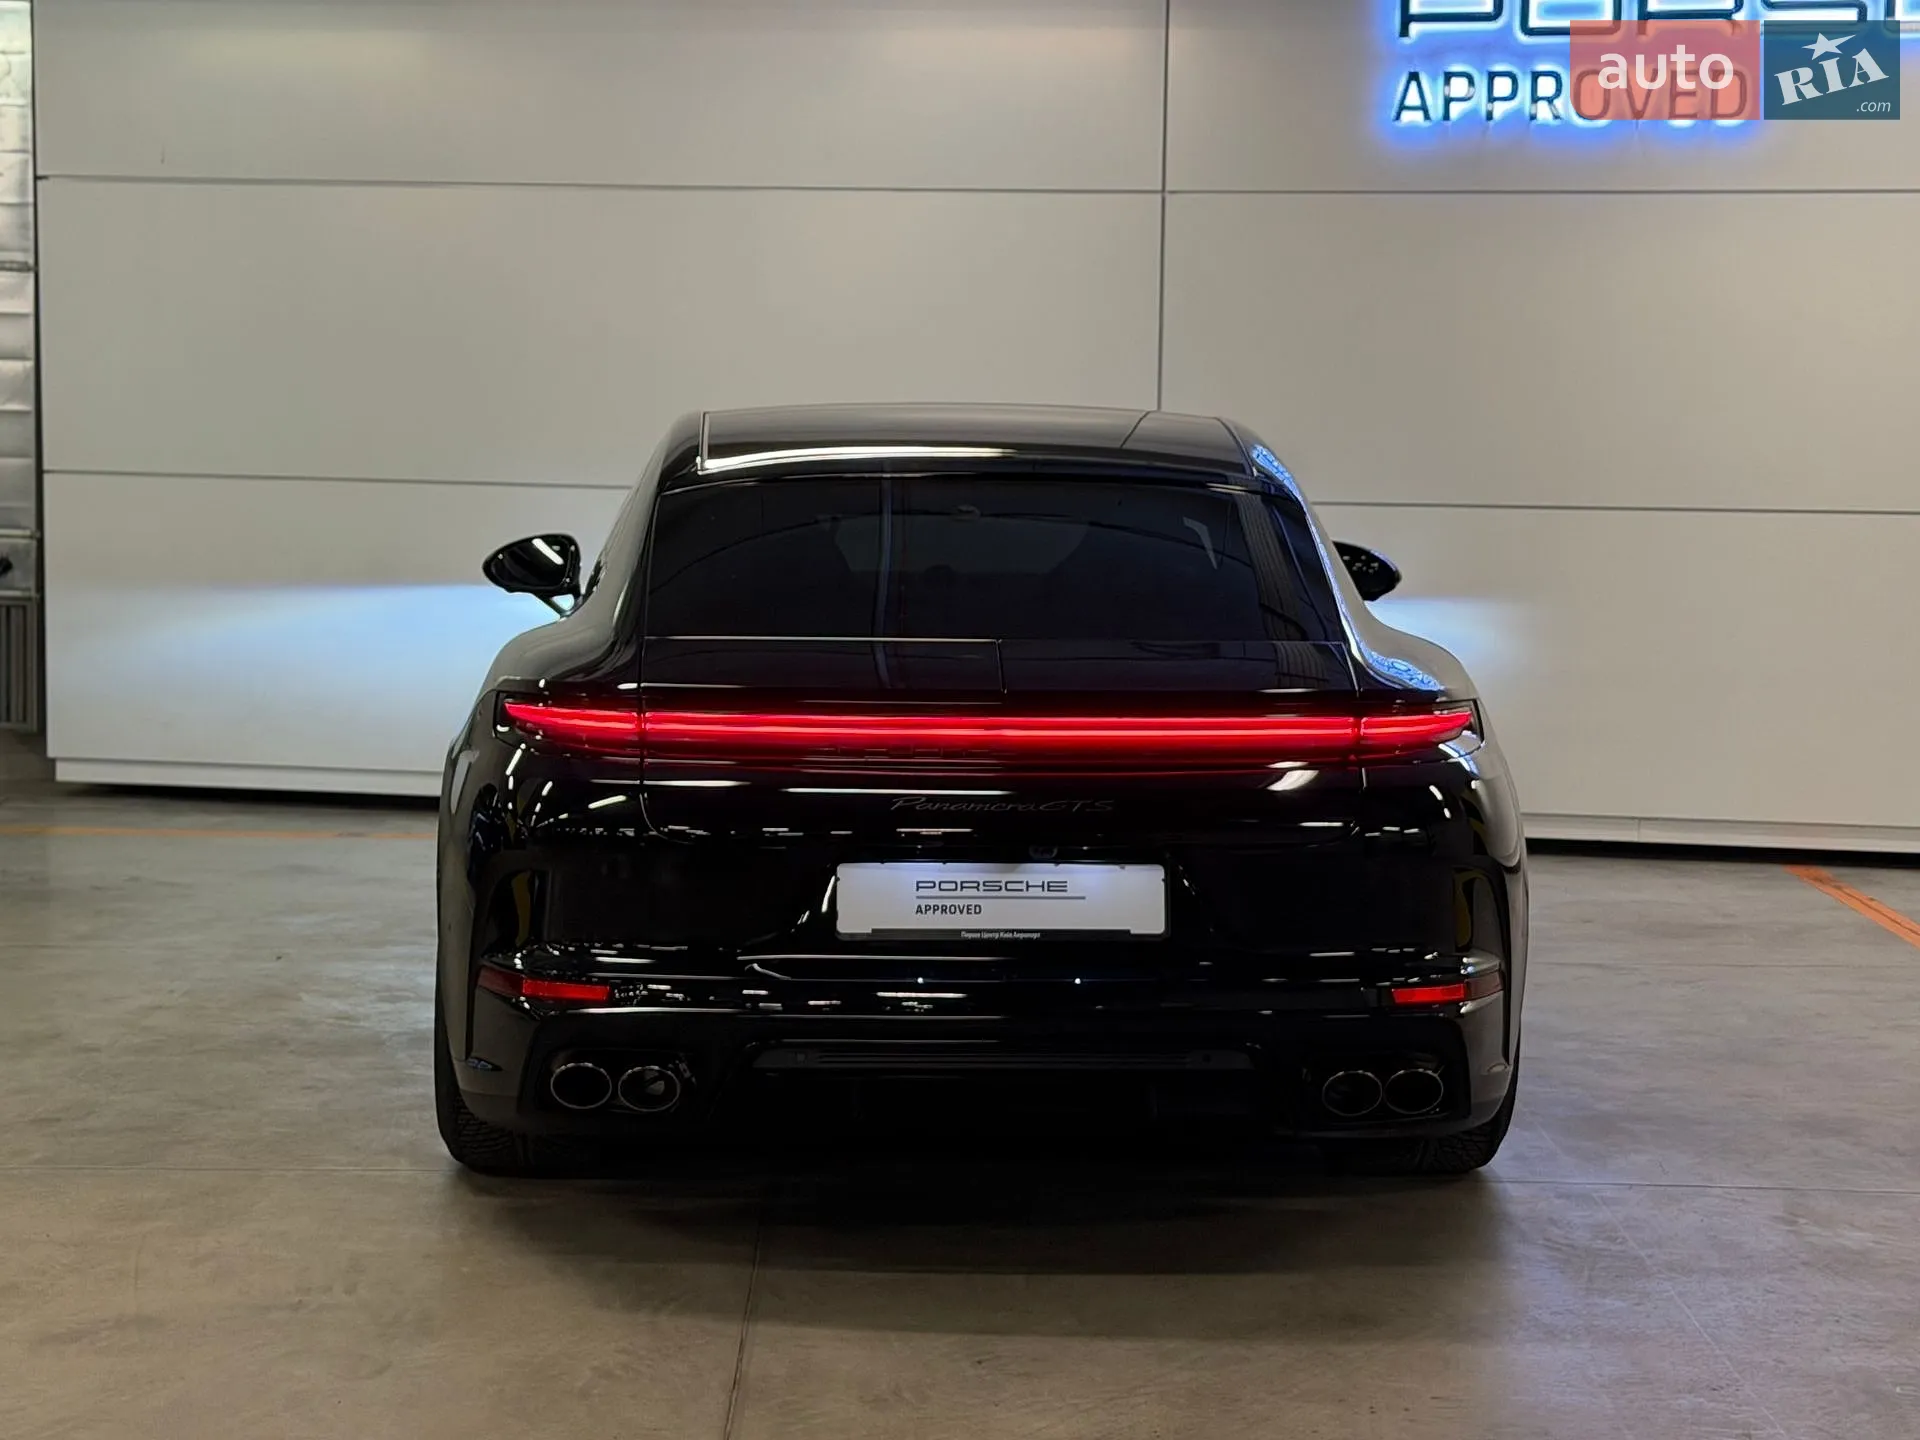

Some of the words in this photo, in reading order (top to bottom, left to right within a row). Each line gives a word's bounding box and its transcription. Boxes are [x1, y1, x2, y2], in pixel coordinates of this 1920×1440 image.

[1393, 69, 1748, 122] APPROVED
[915, 880, 1068, 893] PORSCHE
[915, 903, 982, 915] APPROVED
